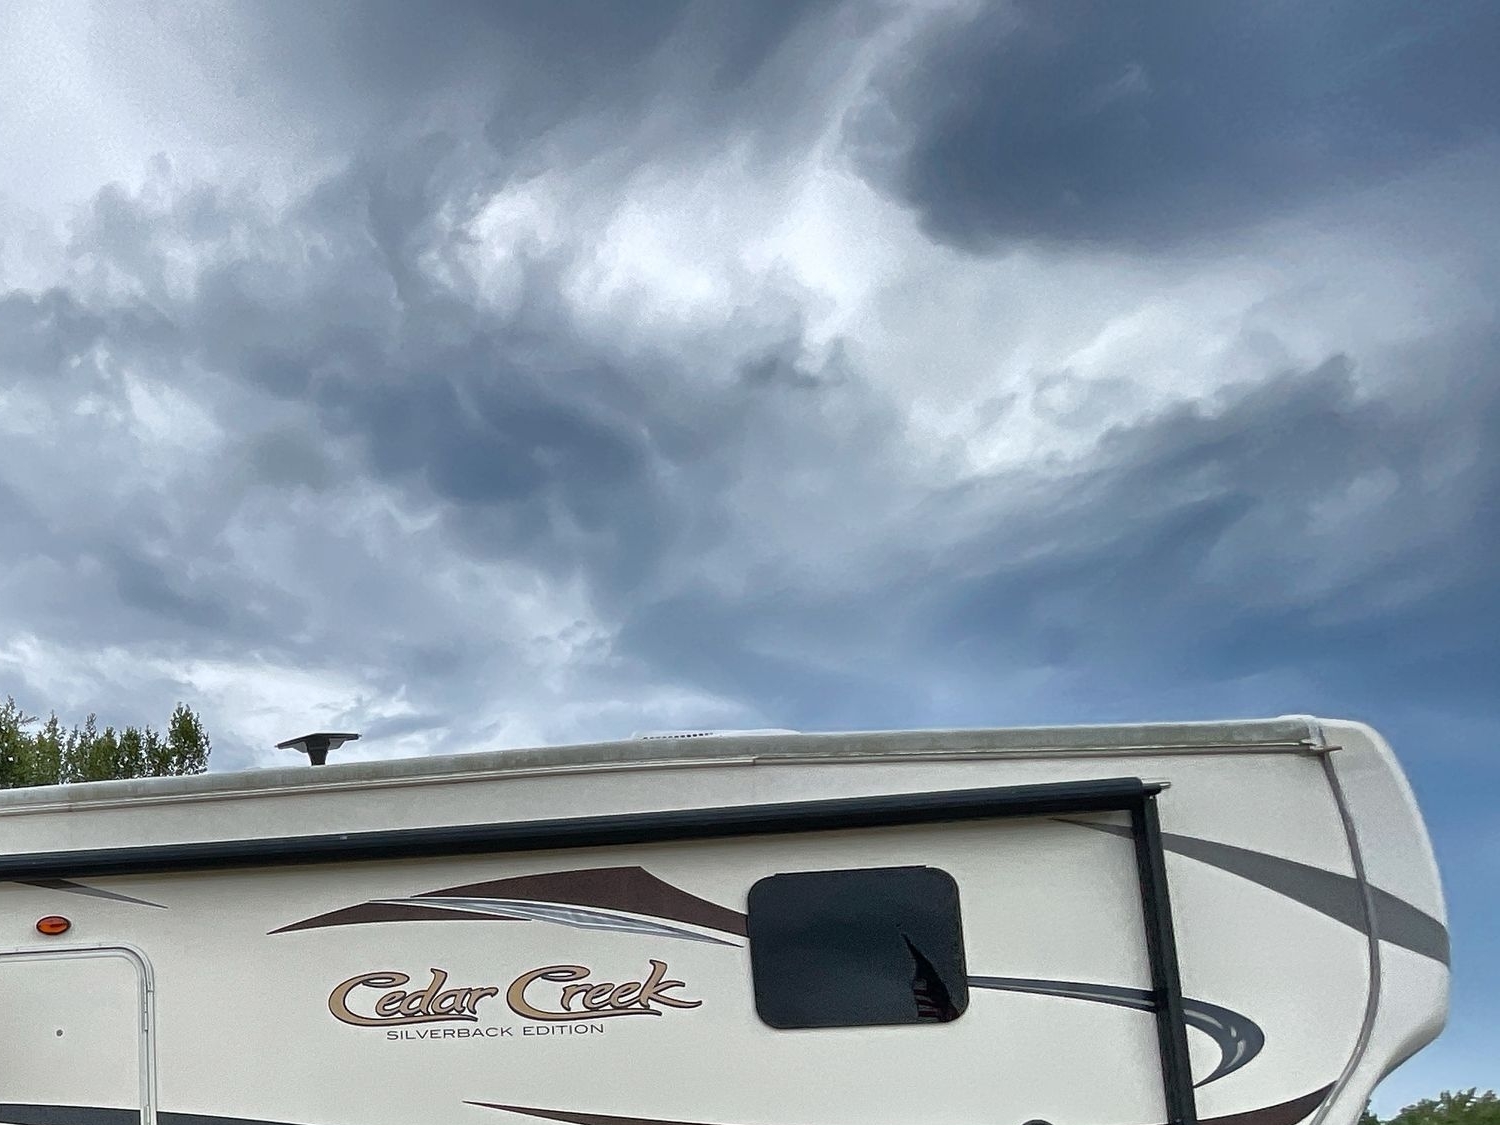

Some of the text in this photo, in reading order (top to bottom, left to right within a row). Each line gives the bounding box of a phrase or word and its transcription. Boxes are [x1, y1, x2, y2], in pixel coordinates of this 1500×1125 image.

[328, 959, 702, 1027] Cedar Creek
[386, 1023, 604, 1041] SILVERBACK EDITION
